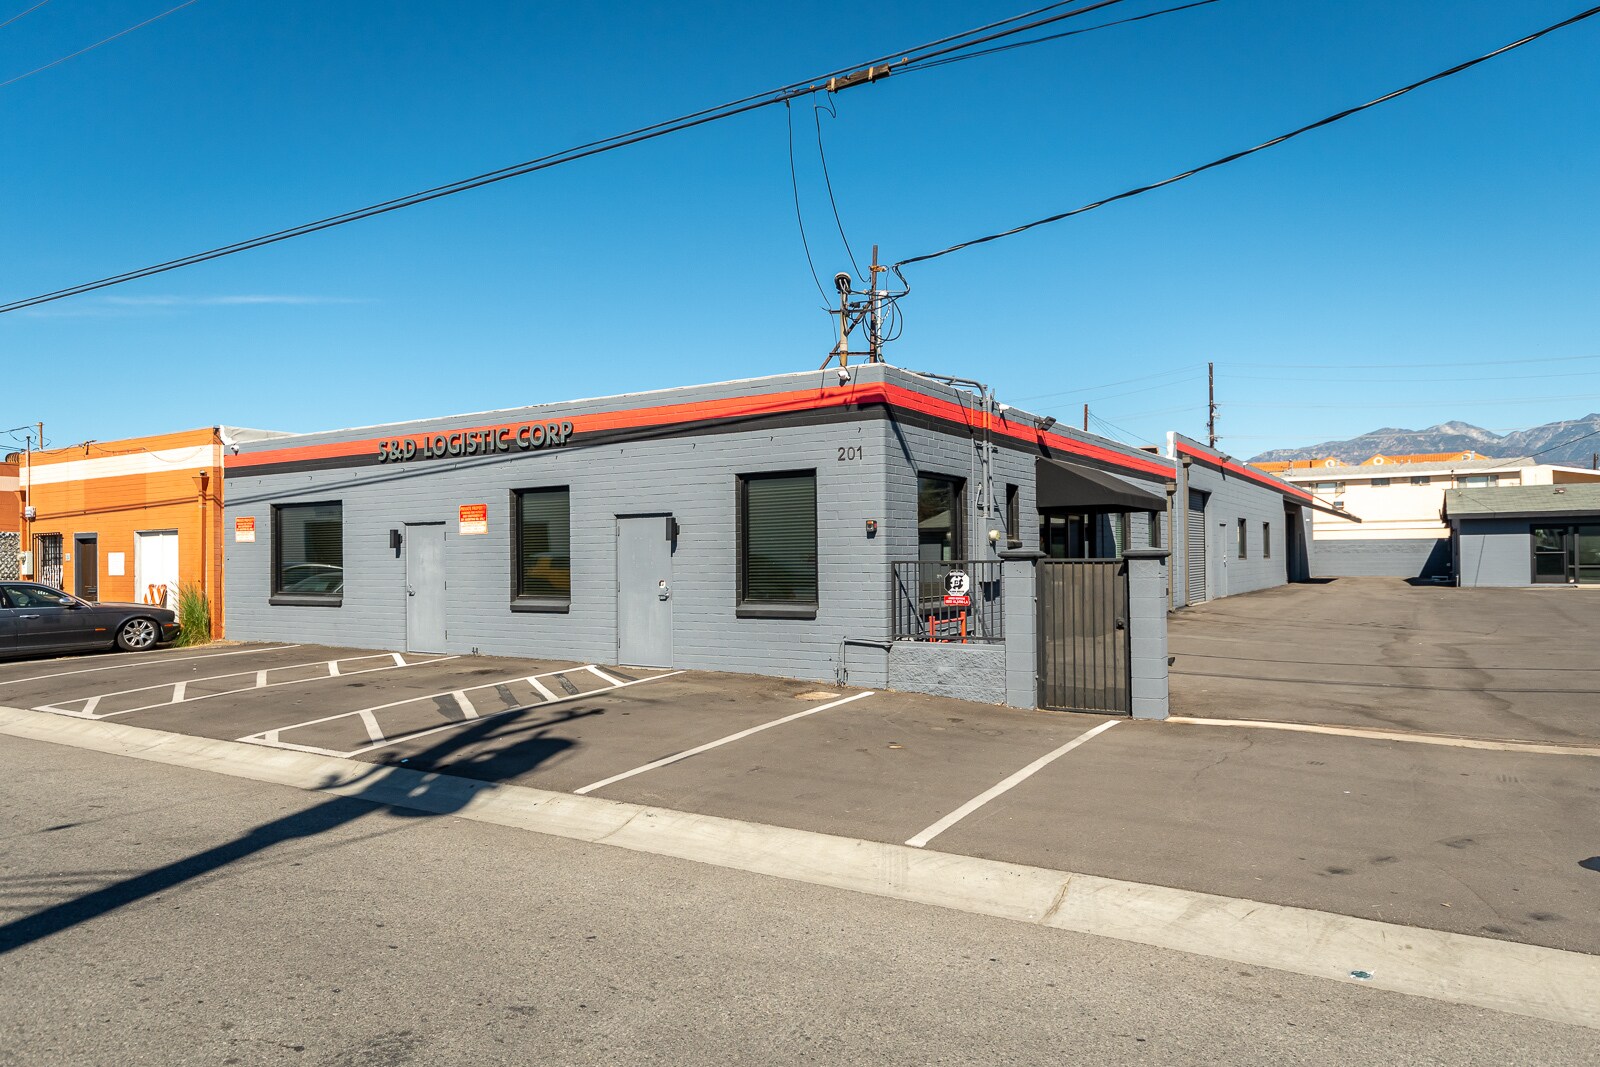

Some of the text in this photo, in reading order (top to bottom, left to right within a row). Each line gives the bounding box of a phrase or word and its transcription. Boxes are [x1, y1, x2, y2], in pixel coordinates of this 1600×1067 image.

[378, 421, 573, 463] S&D LOGISTIC CORP
[837, 445, 863, 461] 201
